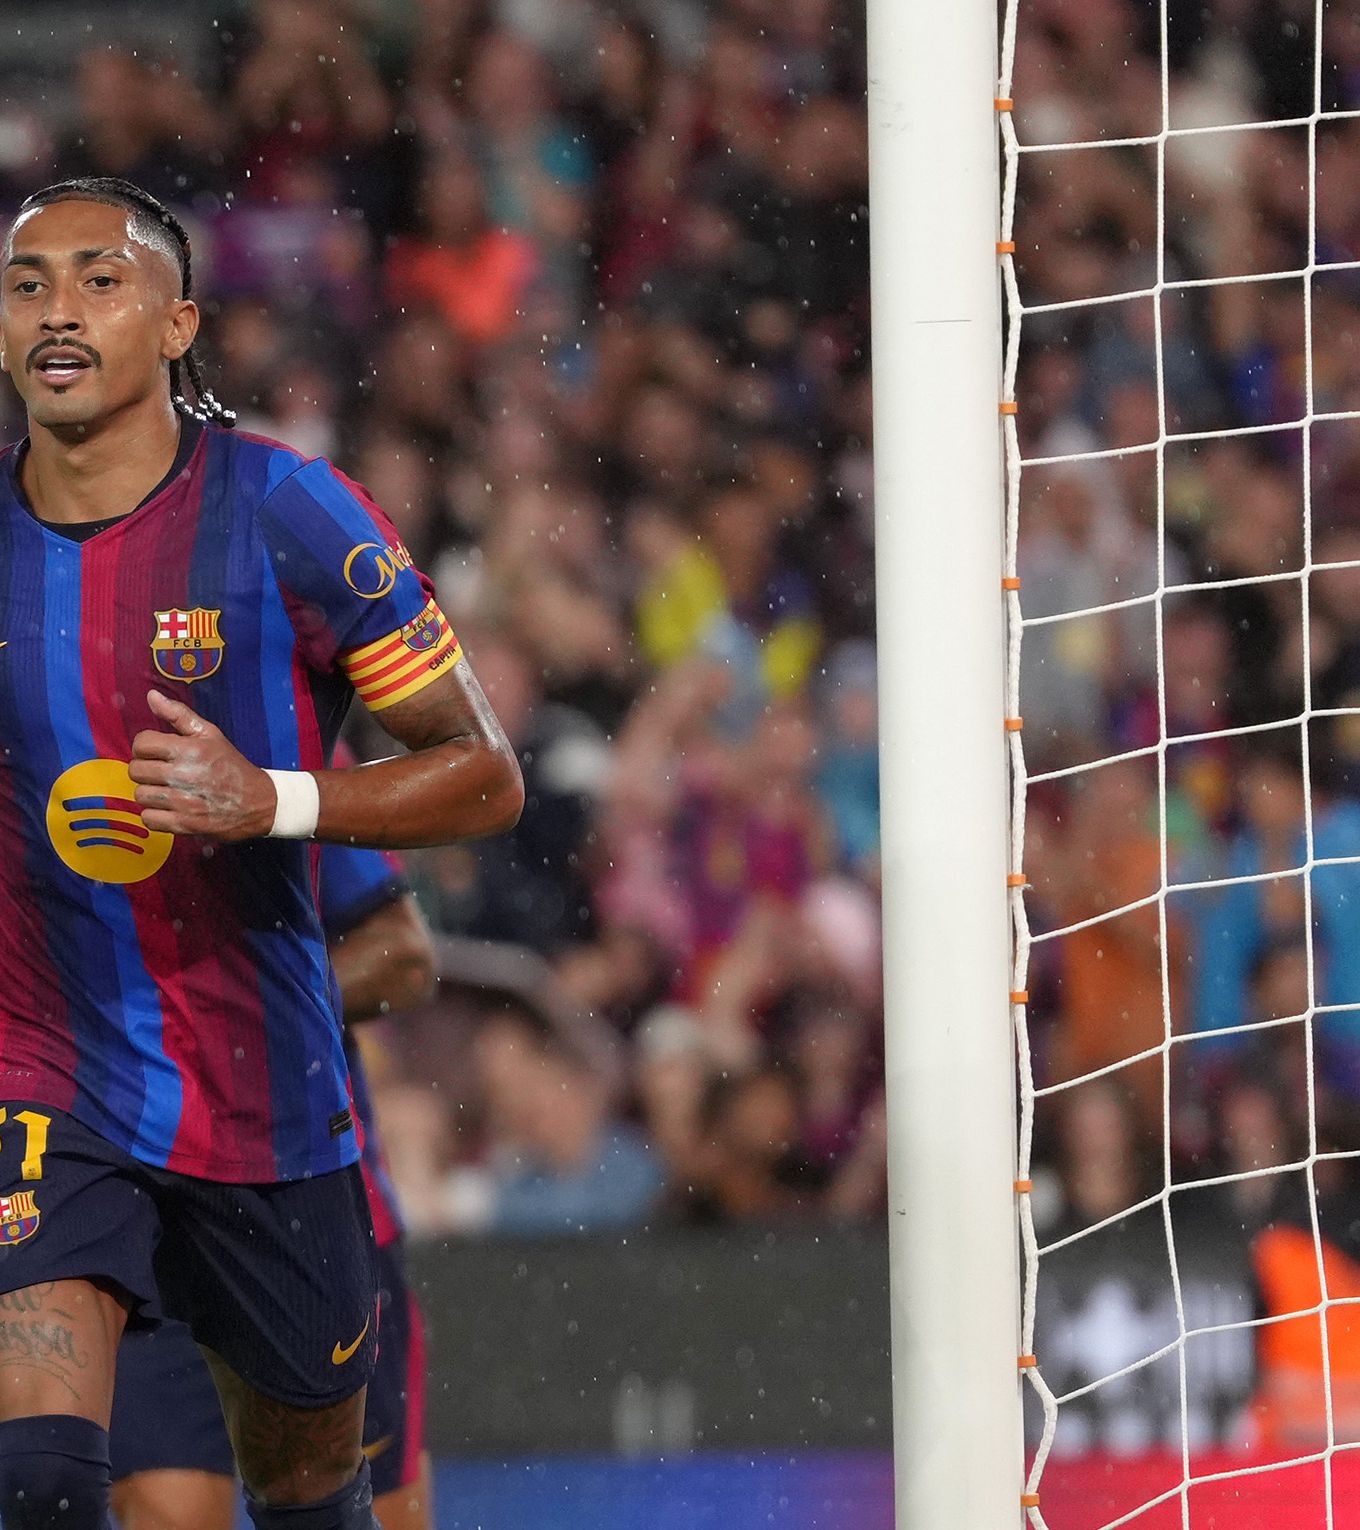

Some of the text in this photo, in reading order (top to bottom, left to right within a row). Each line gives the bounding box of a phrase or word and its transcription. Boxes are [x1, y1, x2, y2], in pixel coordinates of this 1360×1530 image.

[413, 618, 428, 633] FCB
[173, 638, 202, 648] FCB
[1, 1213, 23, 1224] FCB
